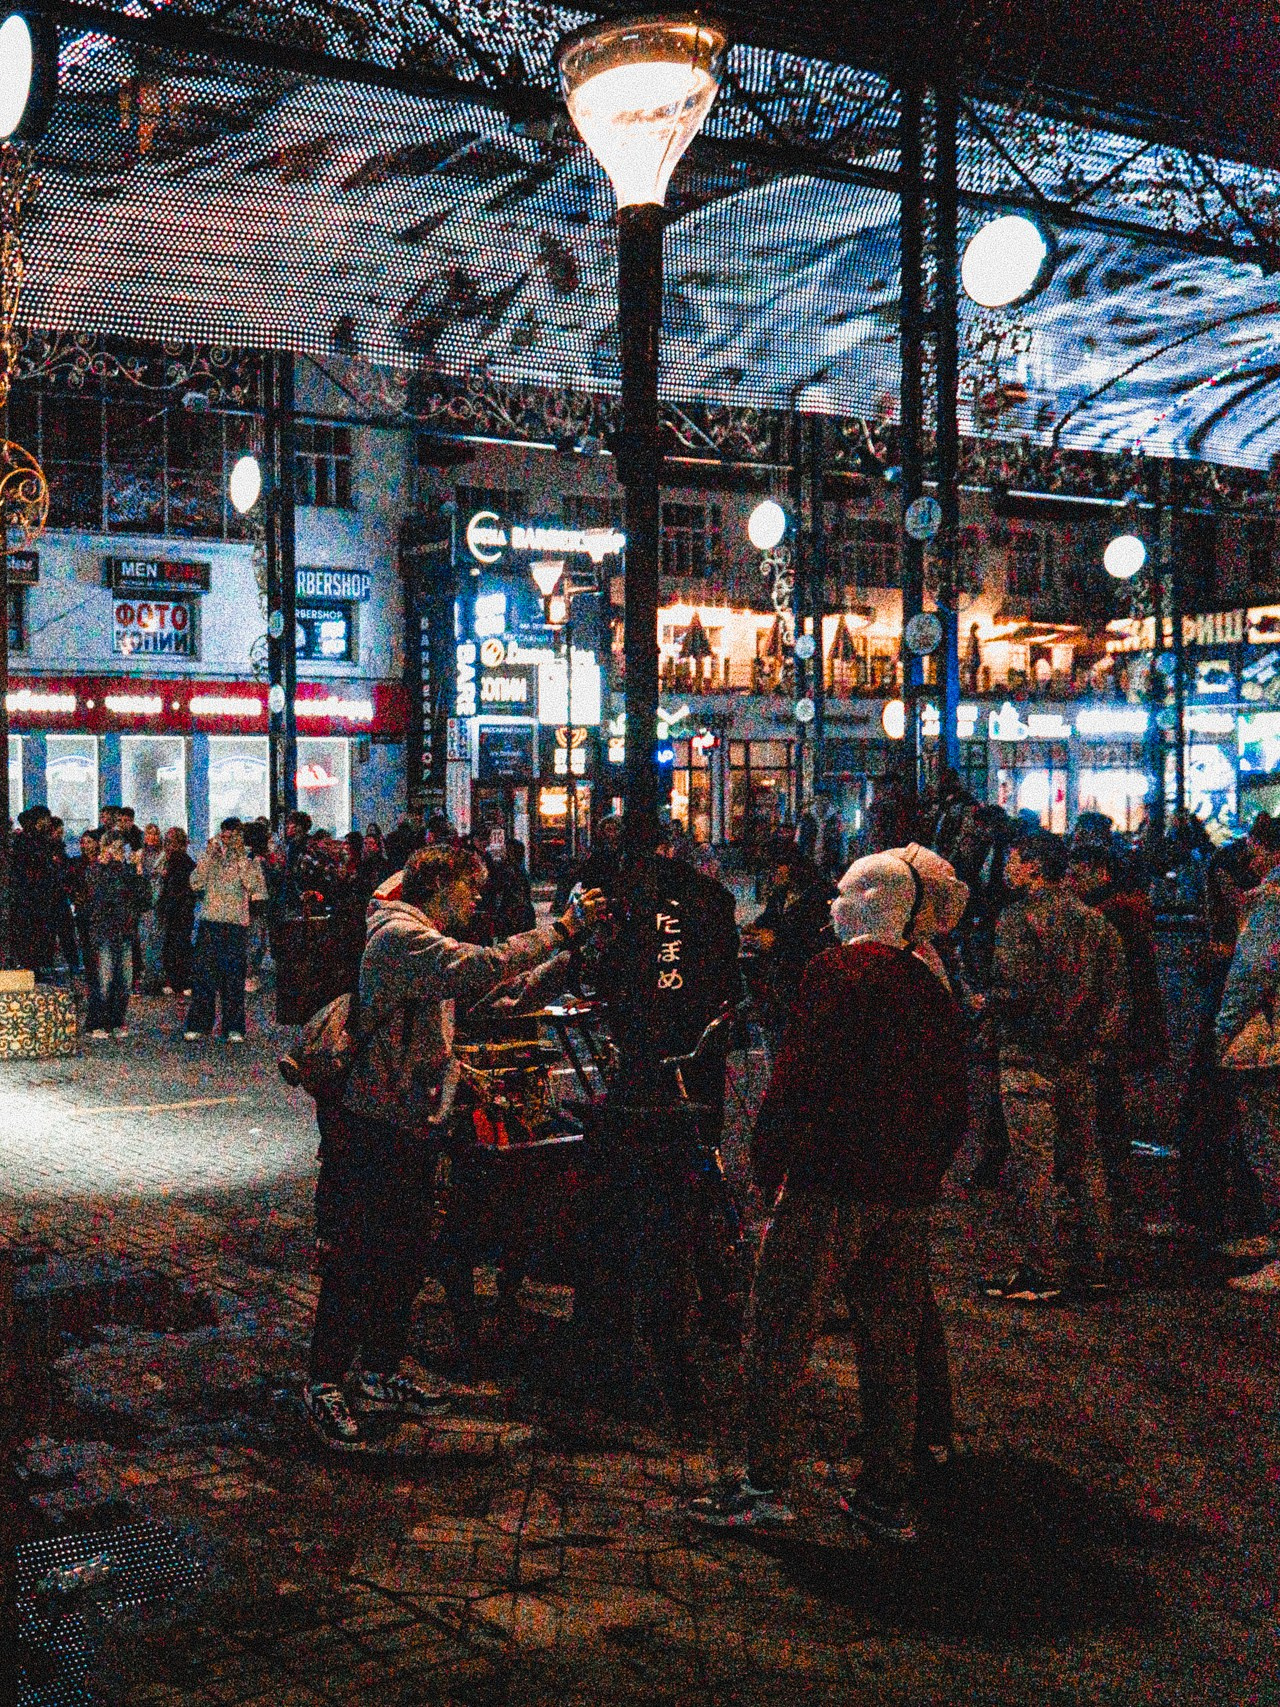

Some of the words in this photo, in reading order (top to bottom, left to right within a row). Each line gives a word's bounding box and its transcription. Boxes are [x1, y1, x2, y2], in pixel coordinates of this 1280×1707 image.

[121, 561, 158, 579] MEN
[297, 571, 371, 598] RBERSHOP
[115, 602, 189, 632] ФОТО
[295, 608, 344, 620] RBERSHOP
